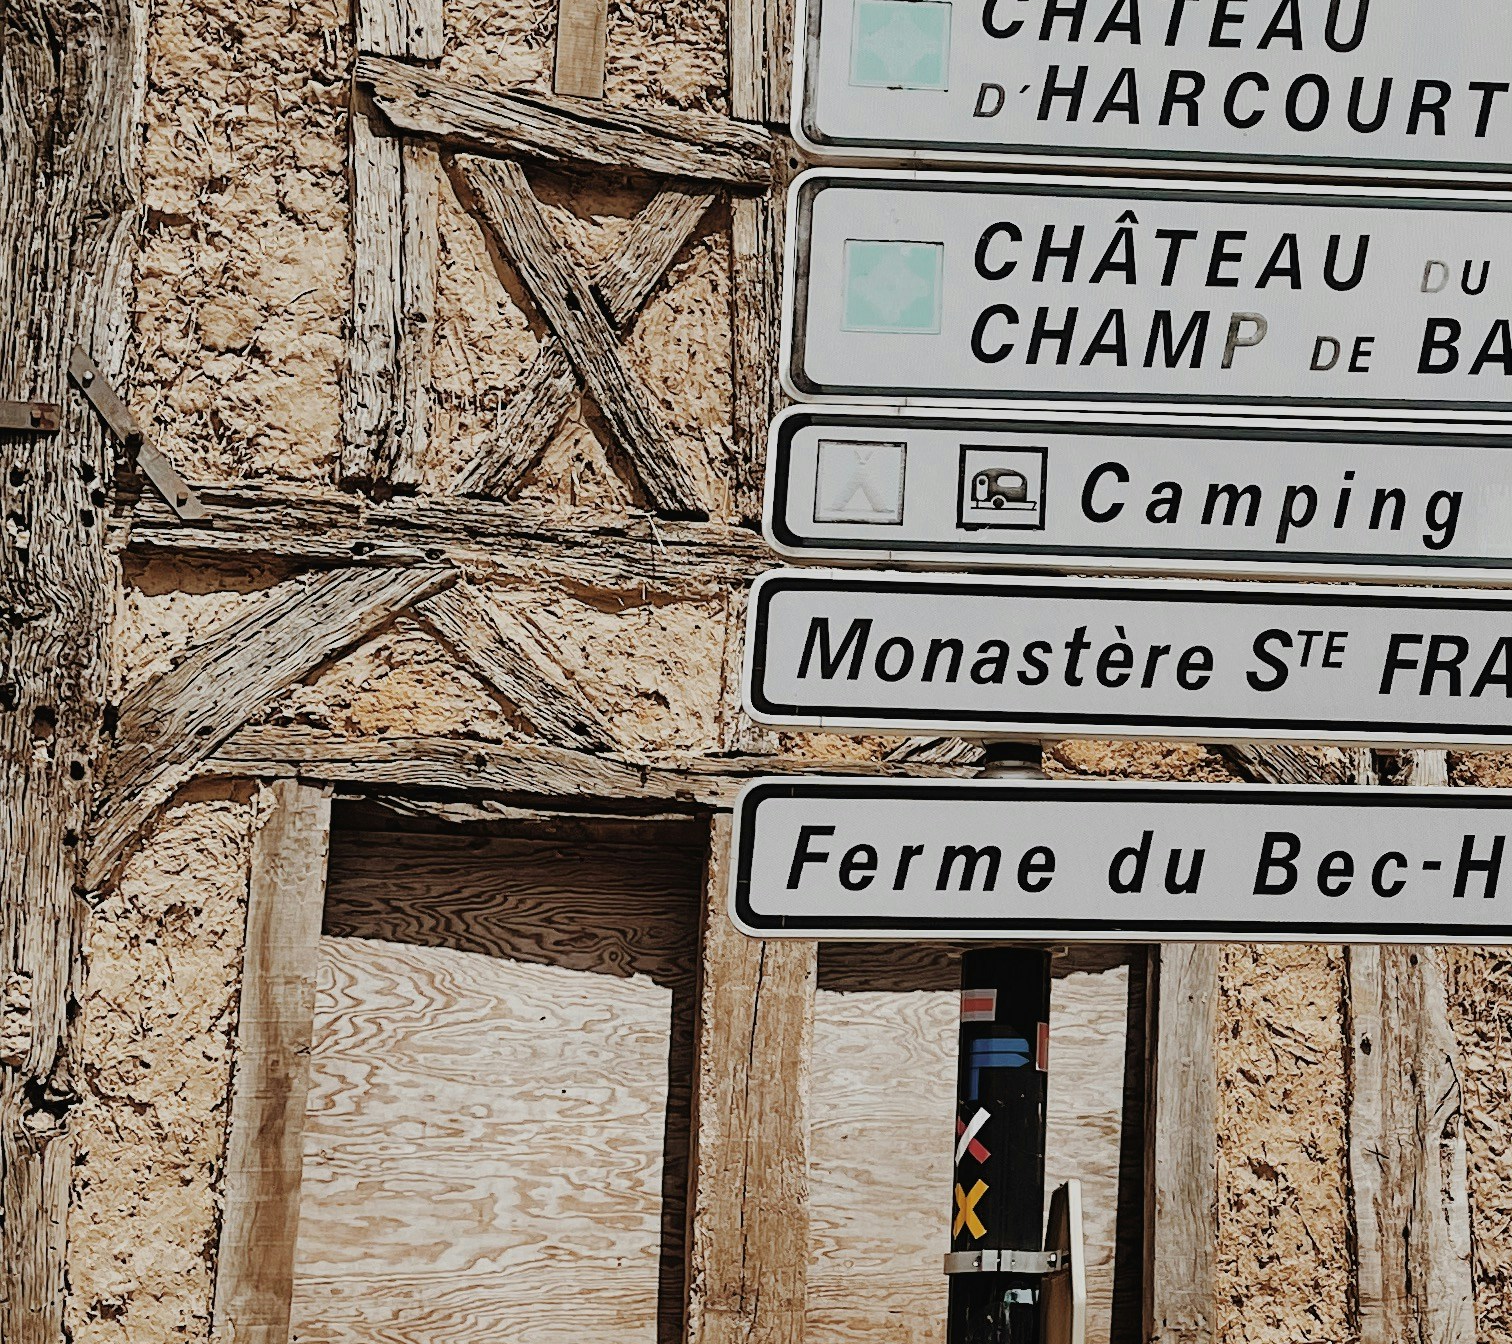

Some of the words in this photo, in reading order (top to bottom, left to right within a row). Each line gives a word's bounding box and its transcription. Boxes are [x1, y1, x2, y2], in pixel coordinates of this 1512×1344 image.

[973, 209, 1370, 292] CHÂTEAU
[1419, 259, 1490, 296] DU
[970, 303, 1268, 370] CHAMP
[1309, 335, 1376, 373] DE
[1081, 461, 1464, 551] Camping
[797, 616, 1215, 691] Monastère
[786, 824, 1057, 894] Ferme
[1108, 829, 1206, 896] du
